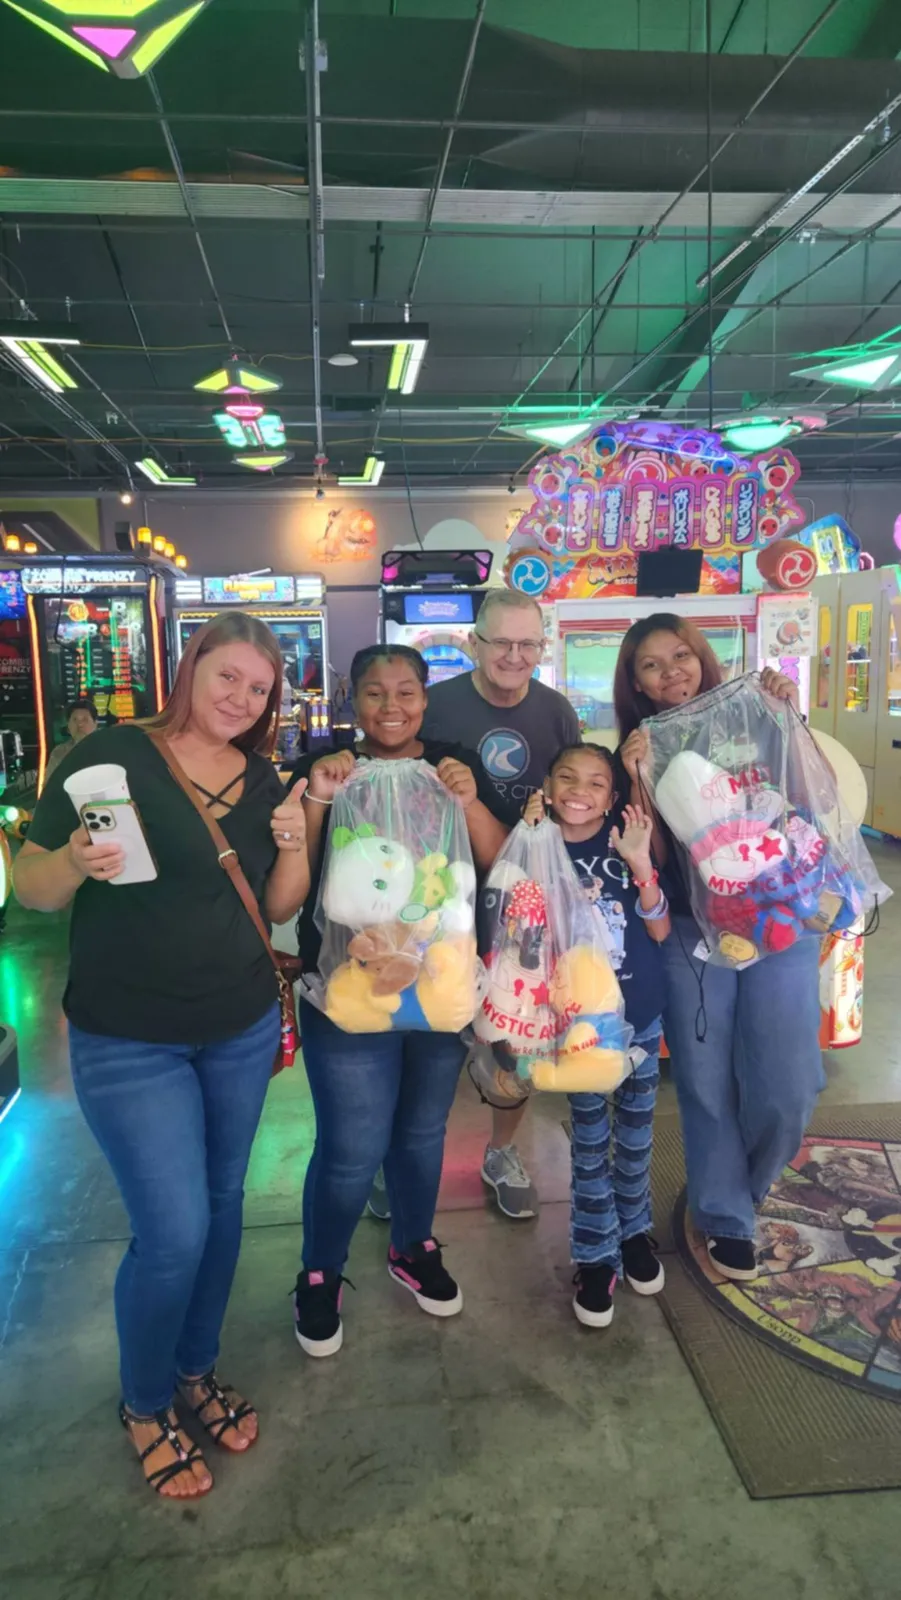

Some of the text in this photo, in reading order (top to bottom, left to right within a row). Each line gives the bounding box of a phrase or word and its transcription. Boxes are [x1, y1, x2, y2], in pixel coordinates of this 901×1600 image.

[0, 657, 30, 667] OMBIE
[0, 665, 32, 674] RENZY
[707, 875, 778, 895] MYSTIC
[481, 995, 536, 1038] MYSTIC
[756, 1313, 803, 1345] Usopp
